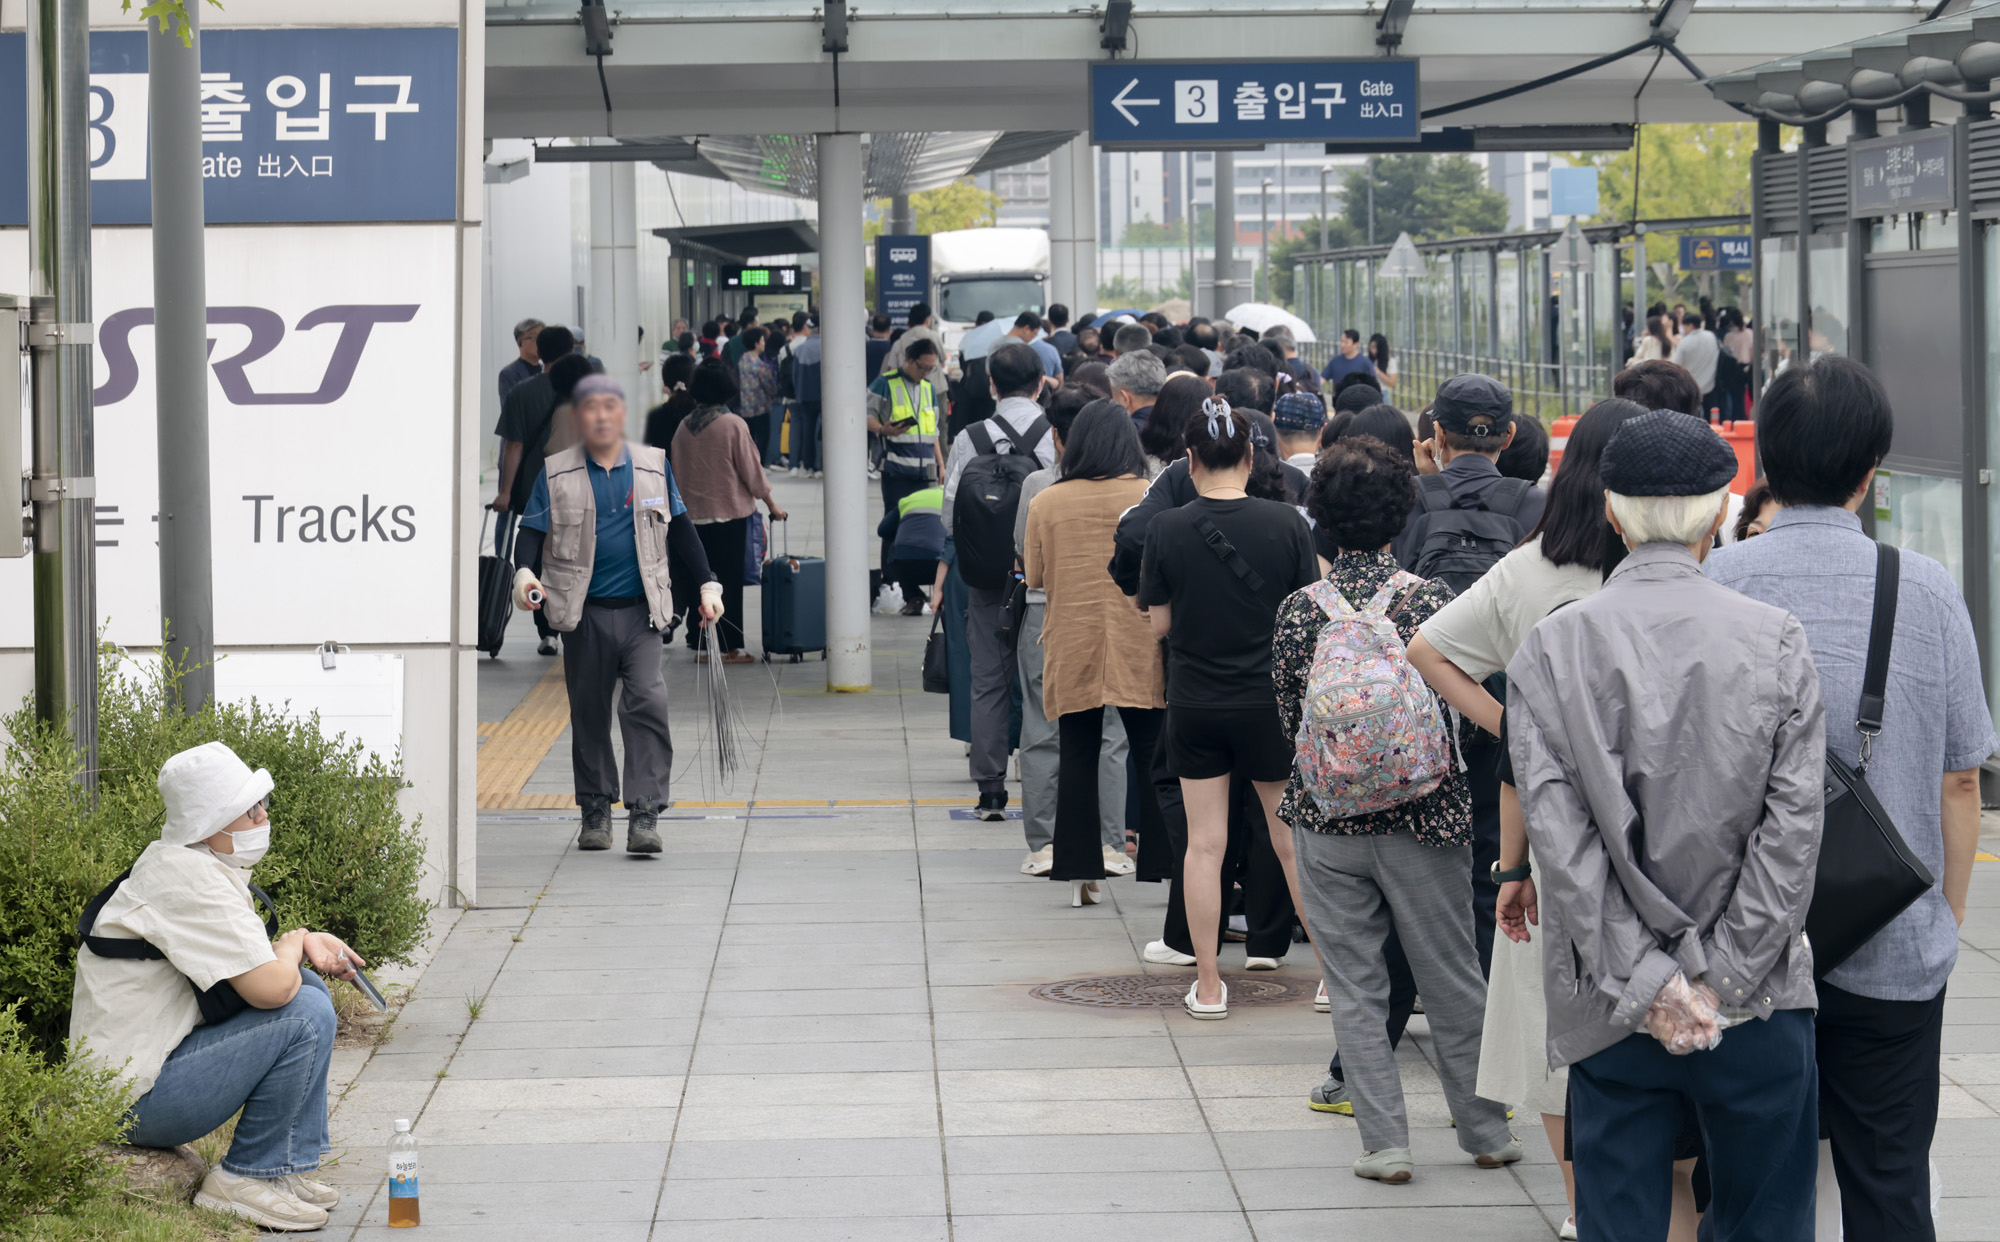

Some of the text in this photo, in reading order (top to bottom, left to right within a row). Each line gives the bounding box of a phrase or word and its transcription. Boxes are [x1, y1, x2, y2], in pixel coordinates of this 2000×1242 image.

[1187, 81, 1347, 120] 3 출입구
[1360, 79, 1394, 97] Gate
[200, 72, 420, 142] 출입구
[1360, 102, 1403, 119] 出入口
[203, 151, 333, 179] ate 出入口
[1721, 241, 1749, 256] 택시
[95, 303, 422, 407] SRT
[242, 494, 417, 543] Tracks
[396, 1162, 416, 1172] 하늘보리
